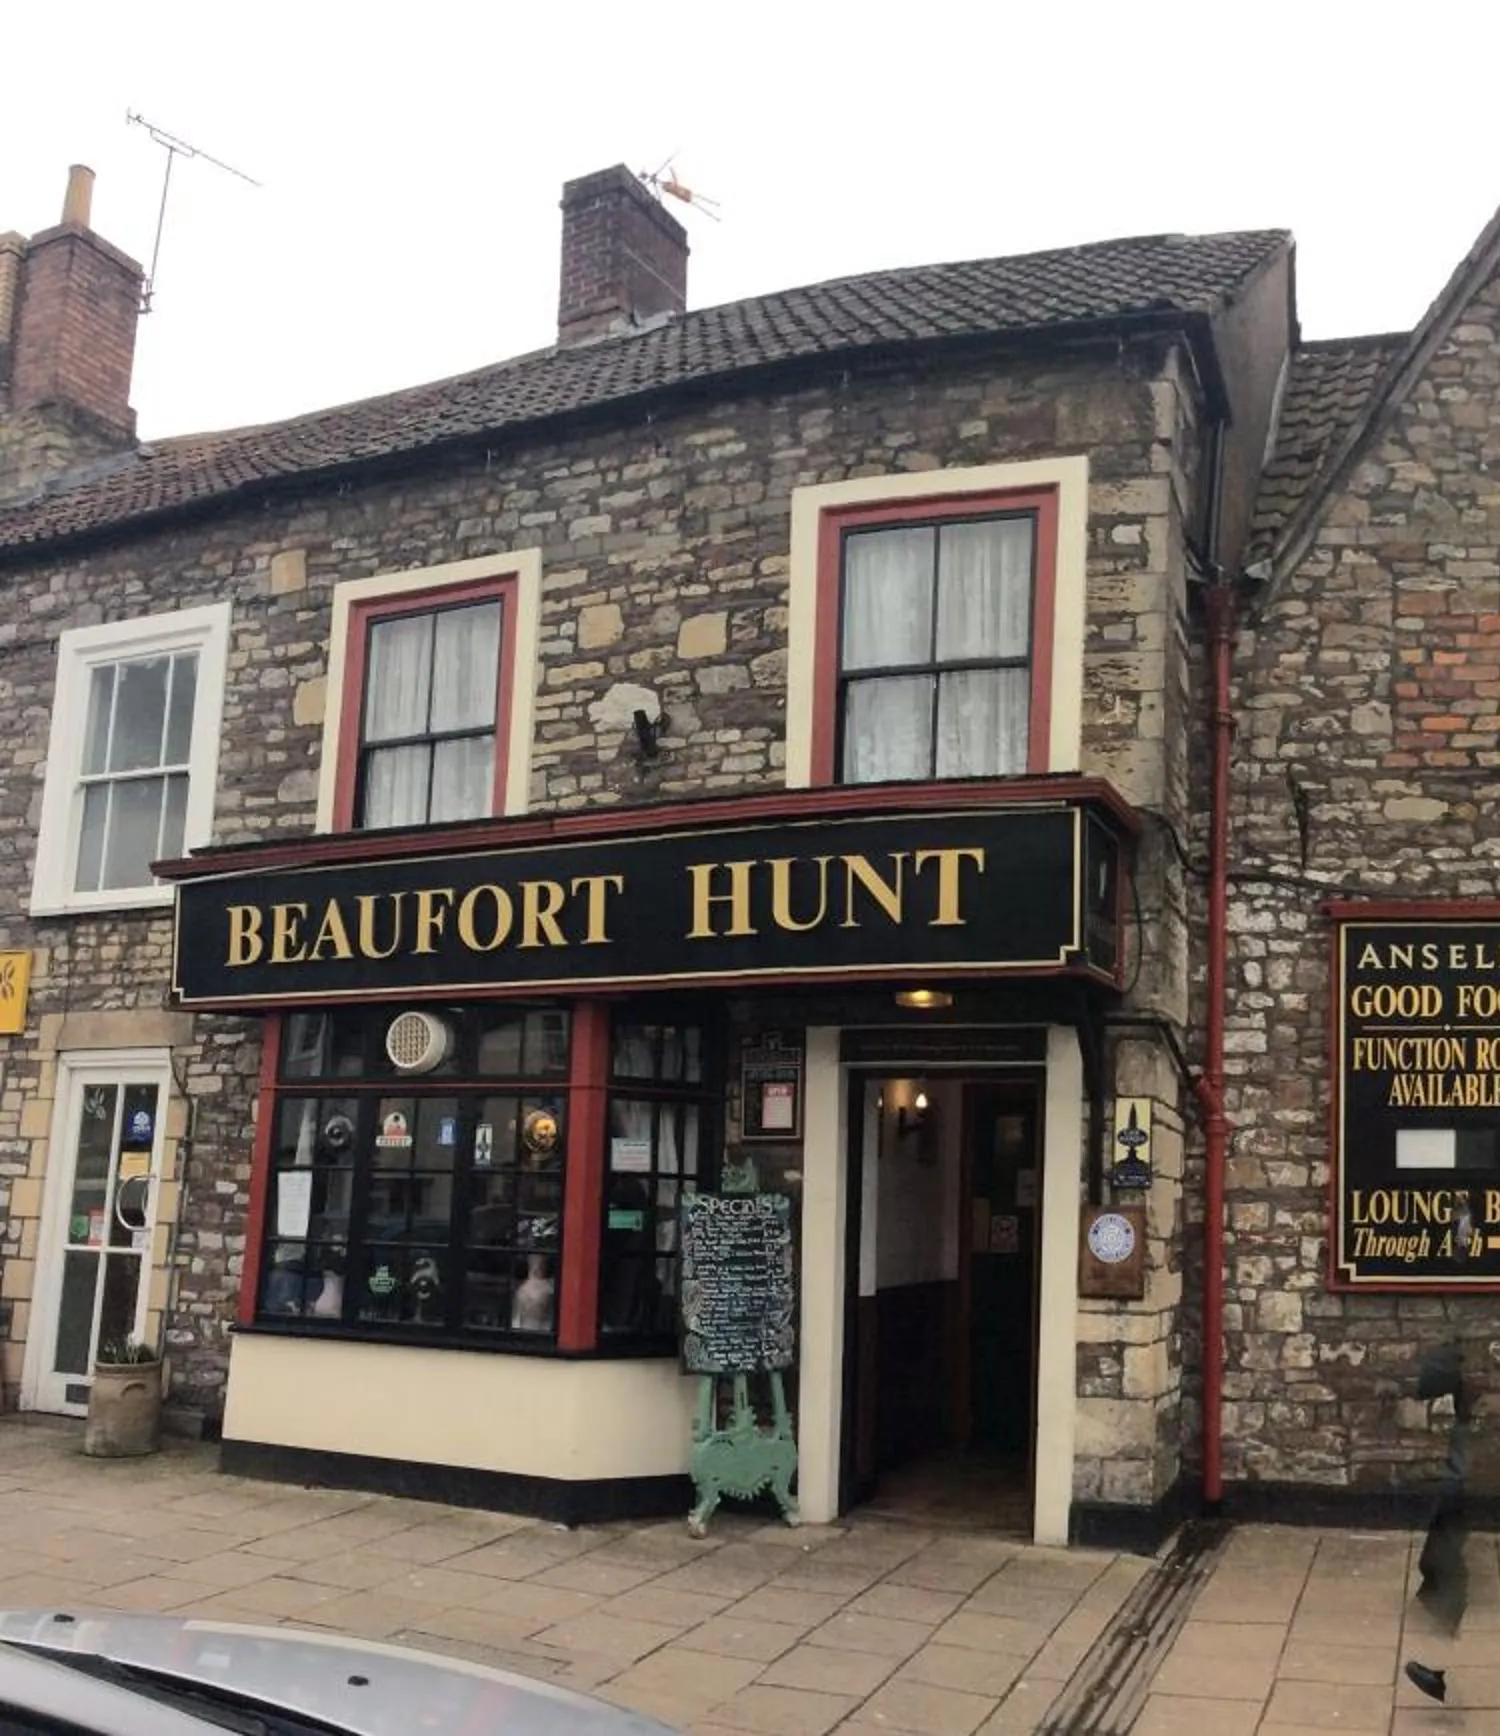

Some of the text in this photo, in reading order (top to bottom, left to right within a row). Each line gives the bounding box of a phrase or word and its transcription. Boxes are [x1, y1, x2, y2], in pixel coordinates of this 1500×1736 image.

[225, 847, 986, 968] BEAUFORT HUNT
[1351, 984, 1443, 1018] GOOD
[1352, 1037, 1467, 1072] FUNCTION
[1353, 1227, 1484, 1262] Through Ah
